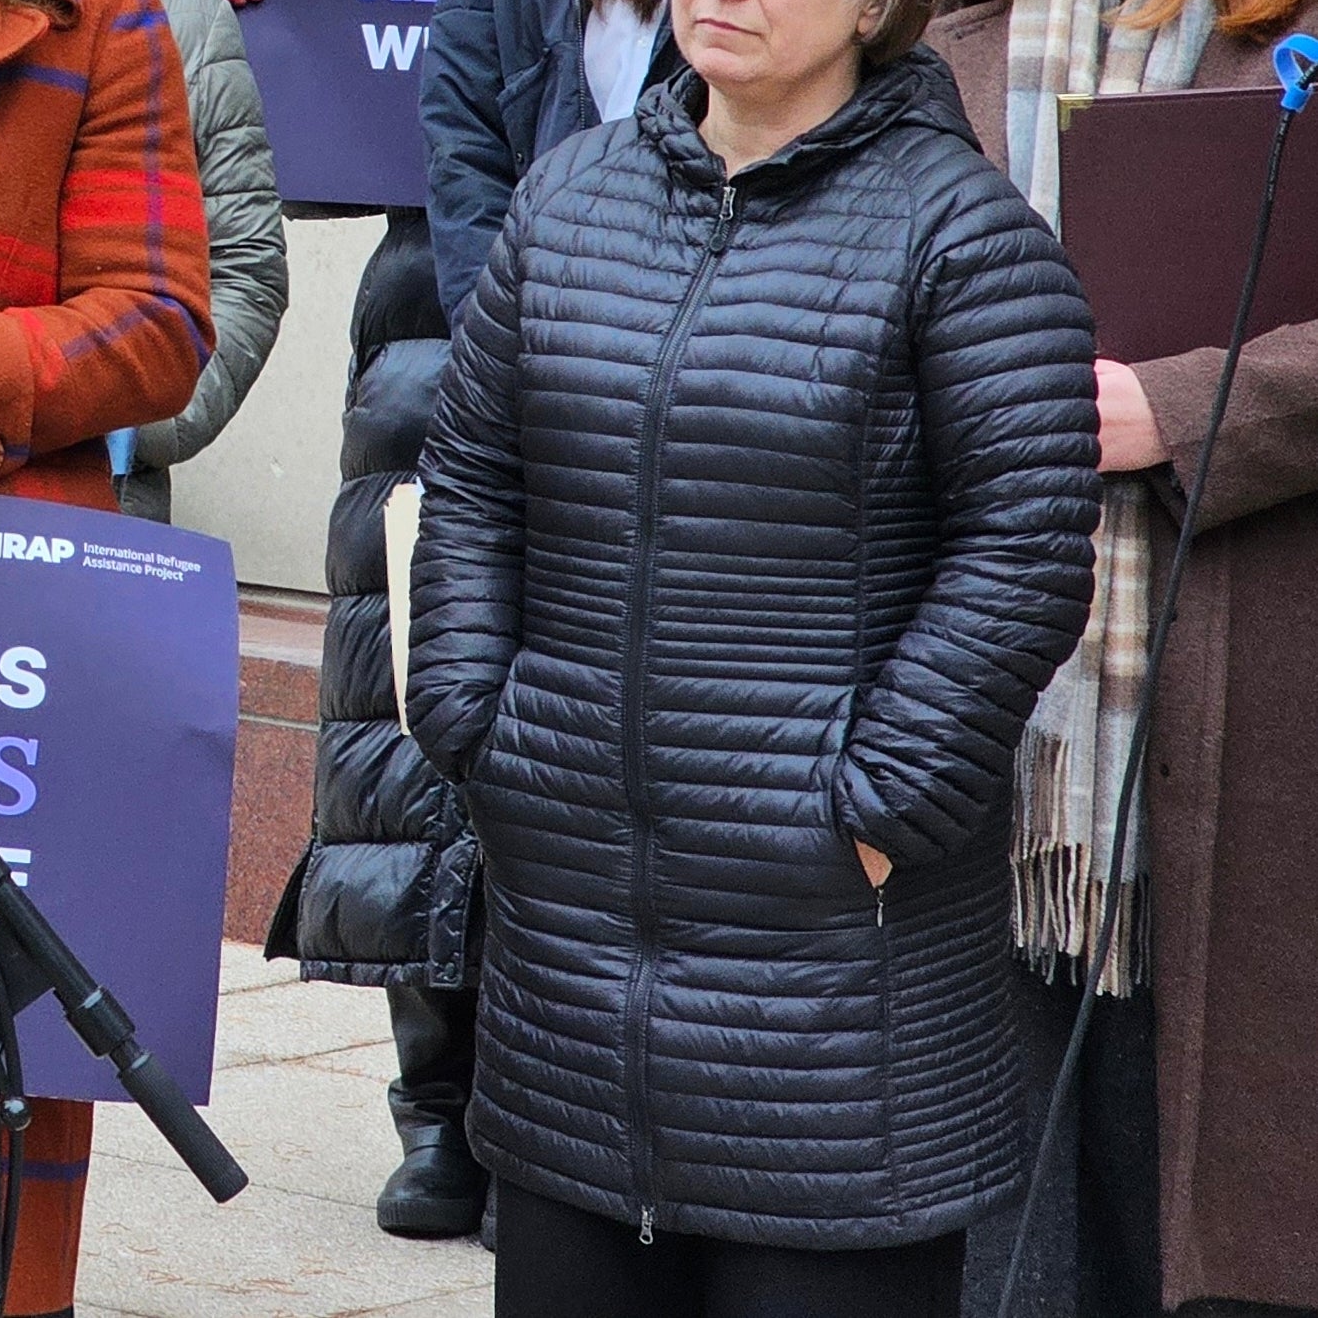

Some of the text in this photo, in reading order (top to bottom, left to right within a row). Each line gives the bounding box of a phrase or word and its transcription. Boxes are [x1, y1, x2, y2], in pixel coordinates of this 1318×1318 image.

[82, 555, 185, 582] Assistance Project
[83, 542, 155, 564] International
[156, 553, 202, 573] Refugee
